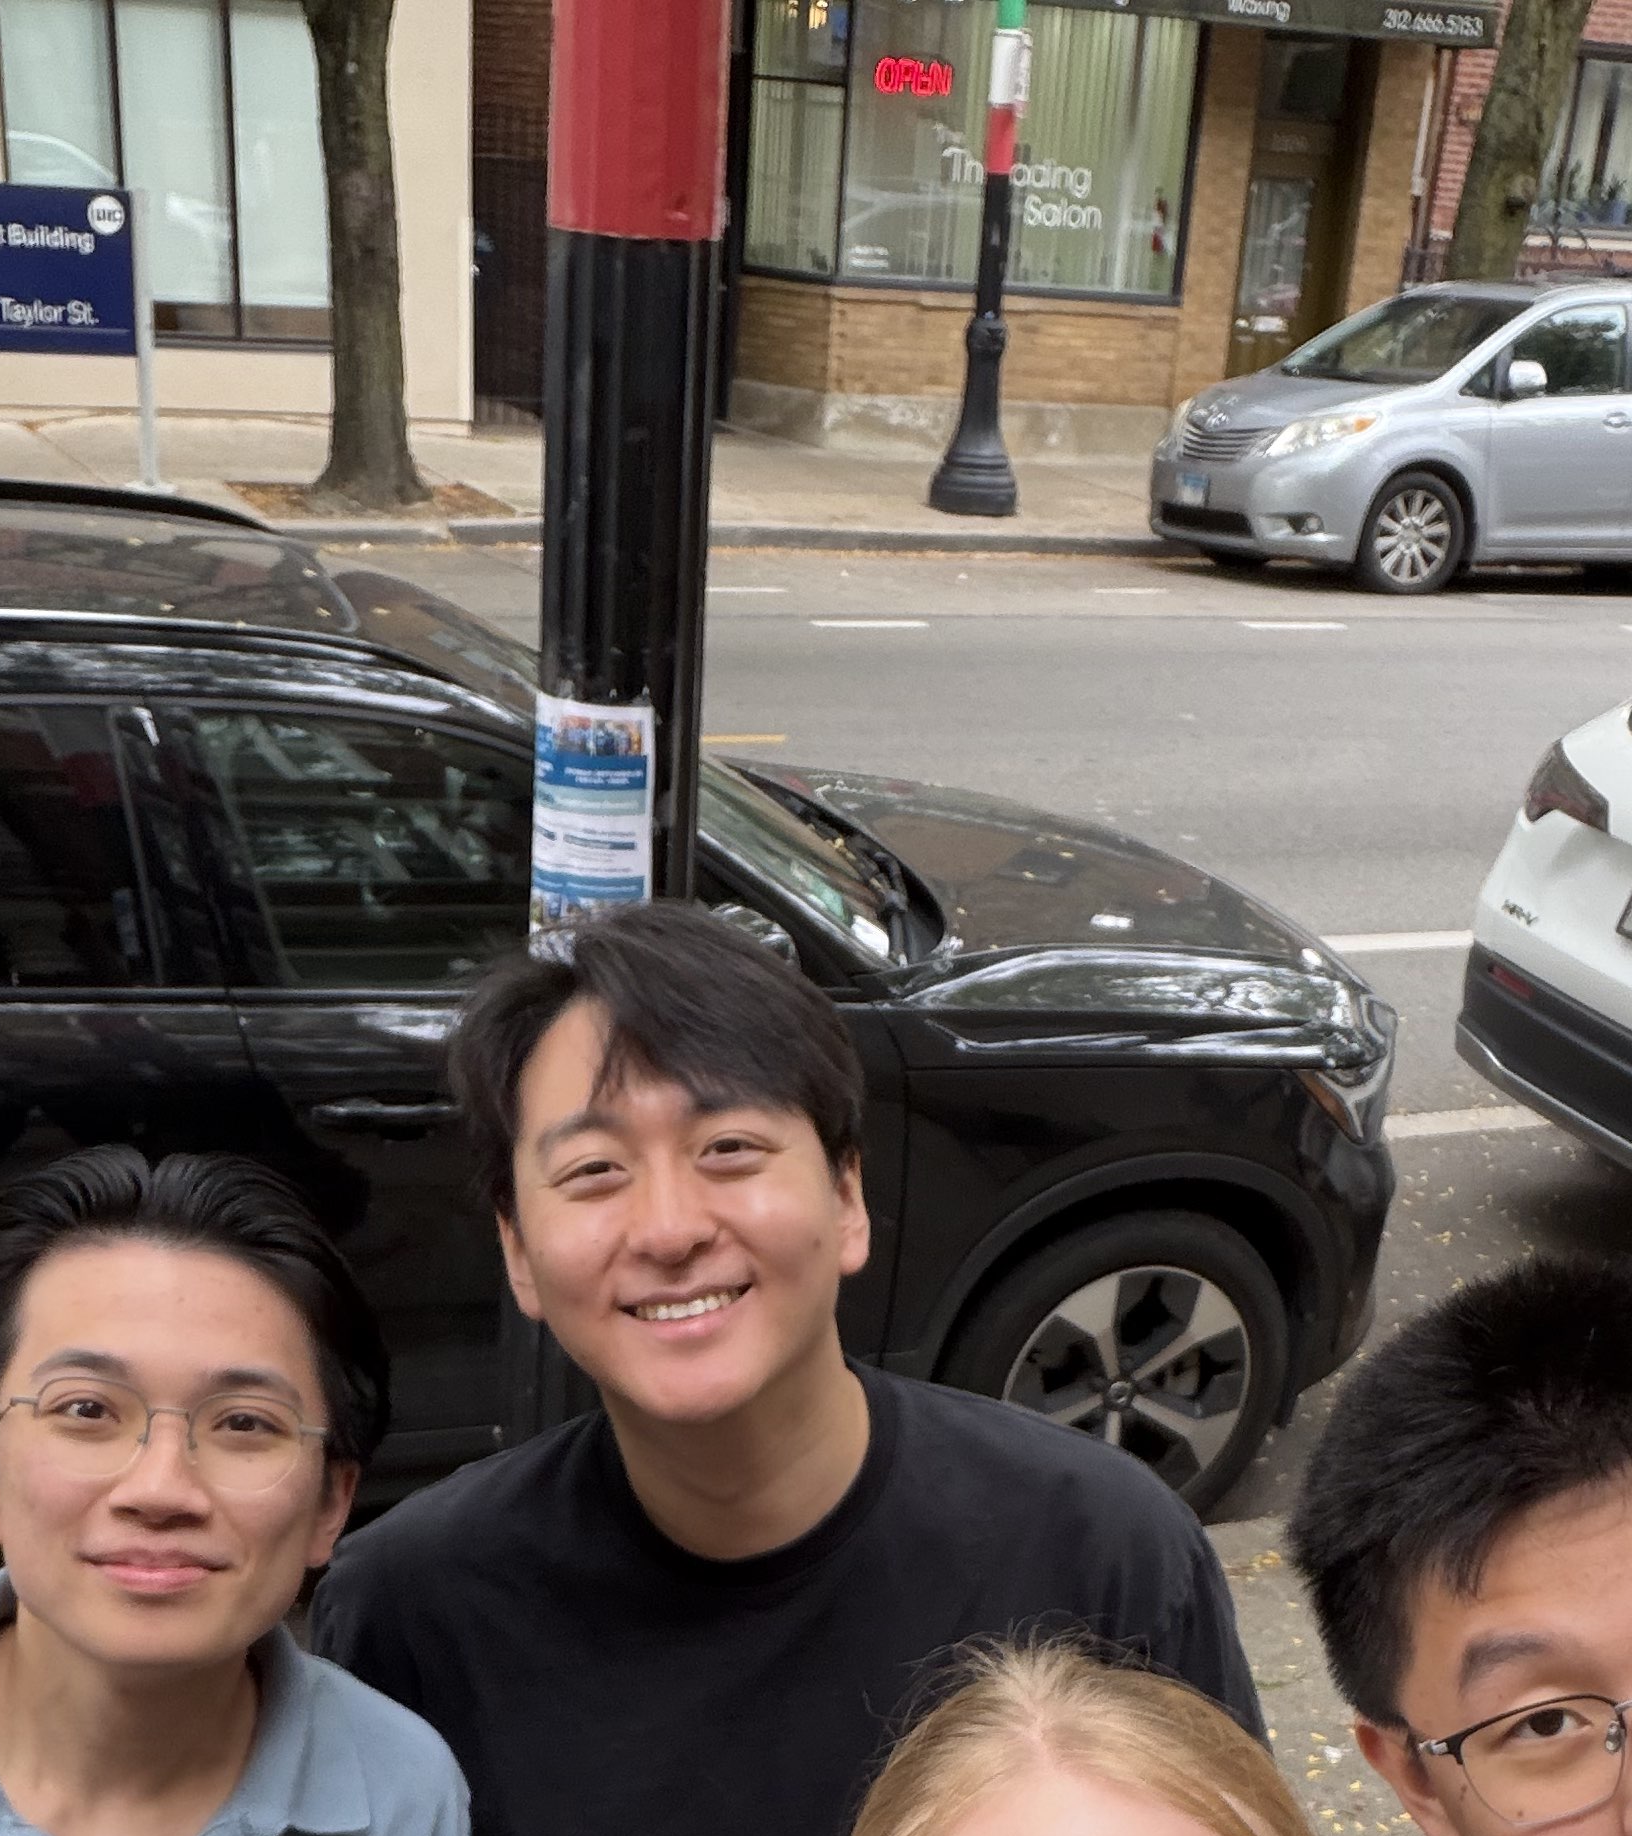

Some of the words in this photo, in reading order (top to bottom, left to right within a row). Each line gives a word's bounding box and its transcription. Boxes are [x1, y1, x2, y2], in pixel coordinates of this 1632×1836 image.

[875, 57, 953, 96] OPEN
[1023, 195, 1103, 229] Salon
[7, 223, 96, 256] Building
[67, 300, 100, 325] St.
